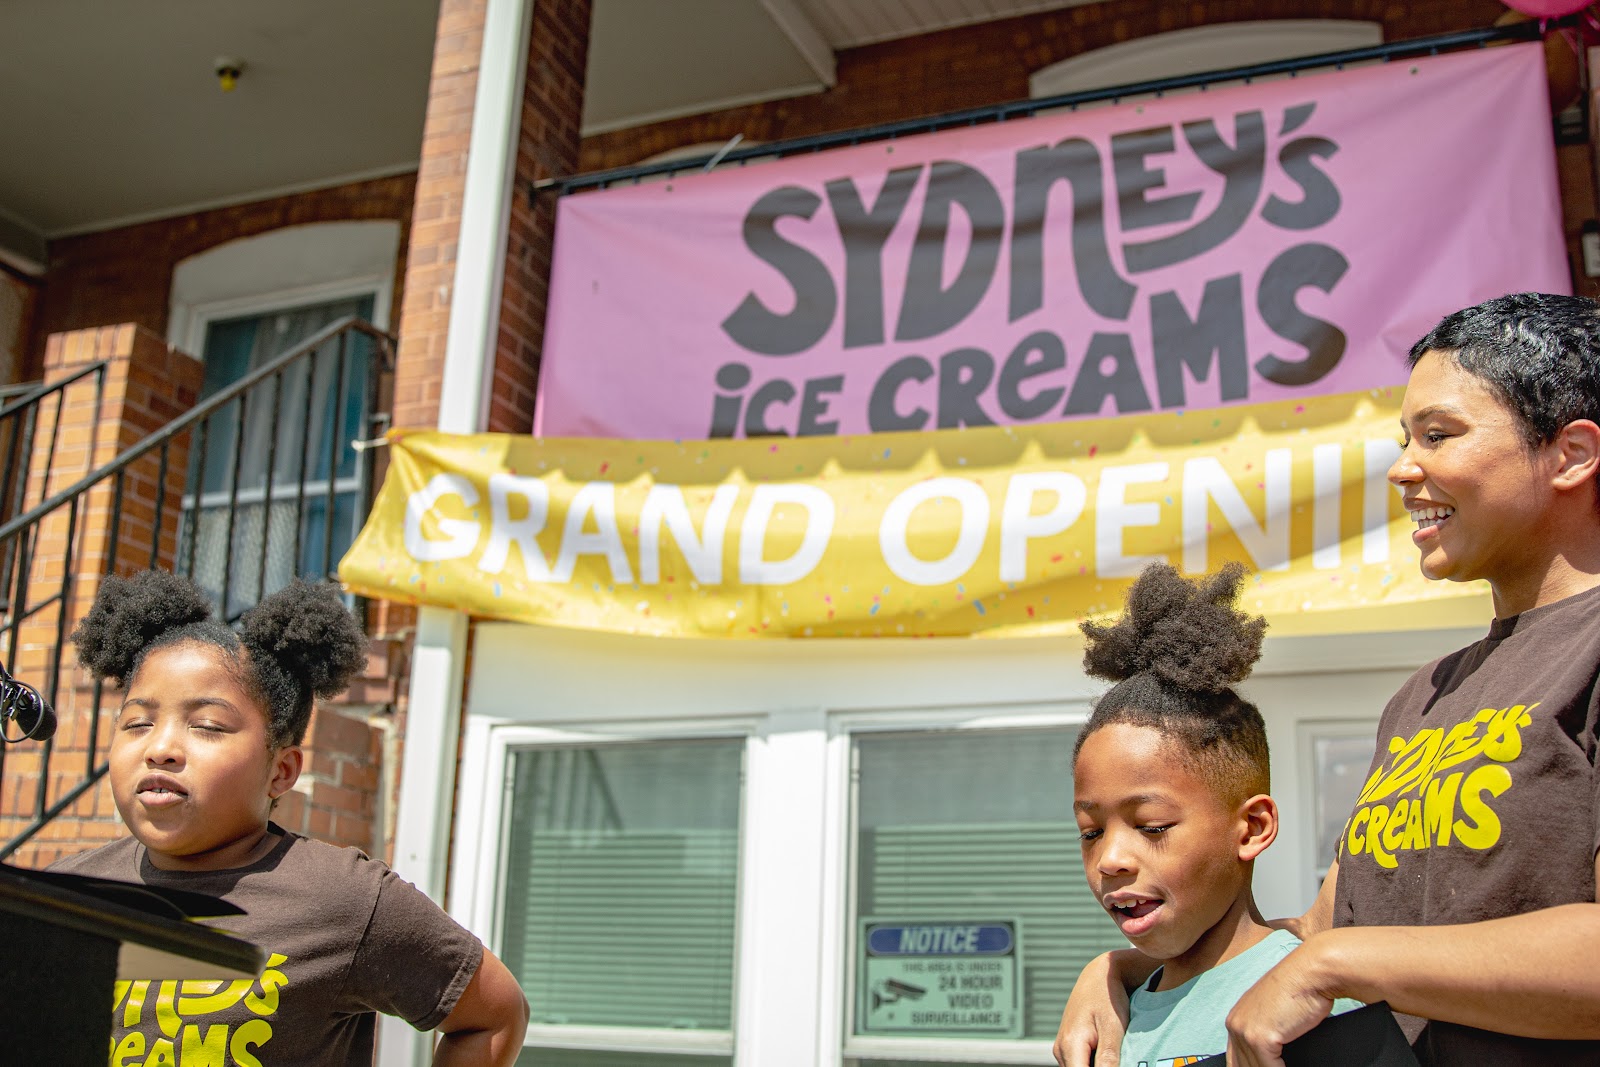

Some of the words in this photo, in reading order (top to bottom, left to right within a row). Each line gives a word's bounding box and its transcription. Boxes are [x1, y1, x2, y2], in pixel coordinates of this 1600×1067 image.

[404, 474, 835, 586] GRAND
[901, 926, 981, 953] NOTICE
[938, 975, 957, 991] 24
[960, 975, 1003, 990] HOUR
[948, 993, 995, 1009] VIDEO
[911, 1011, 1002, 1025] SURVEILLANCE
